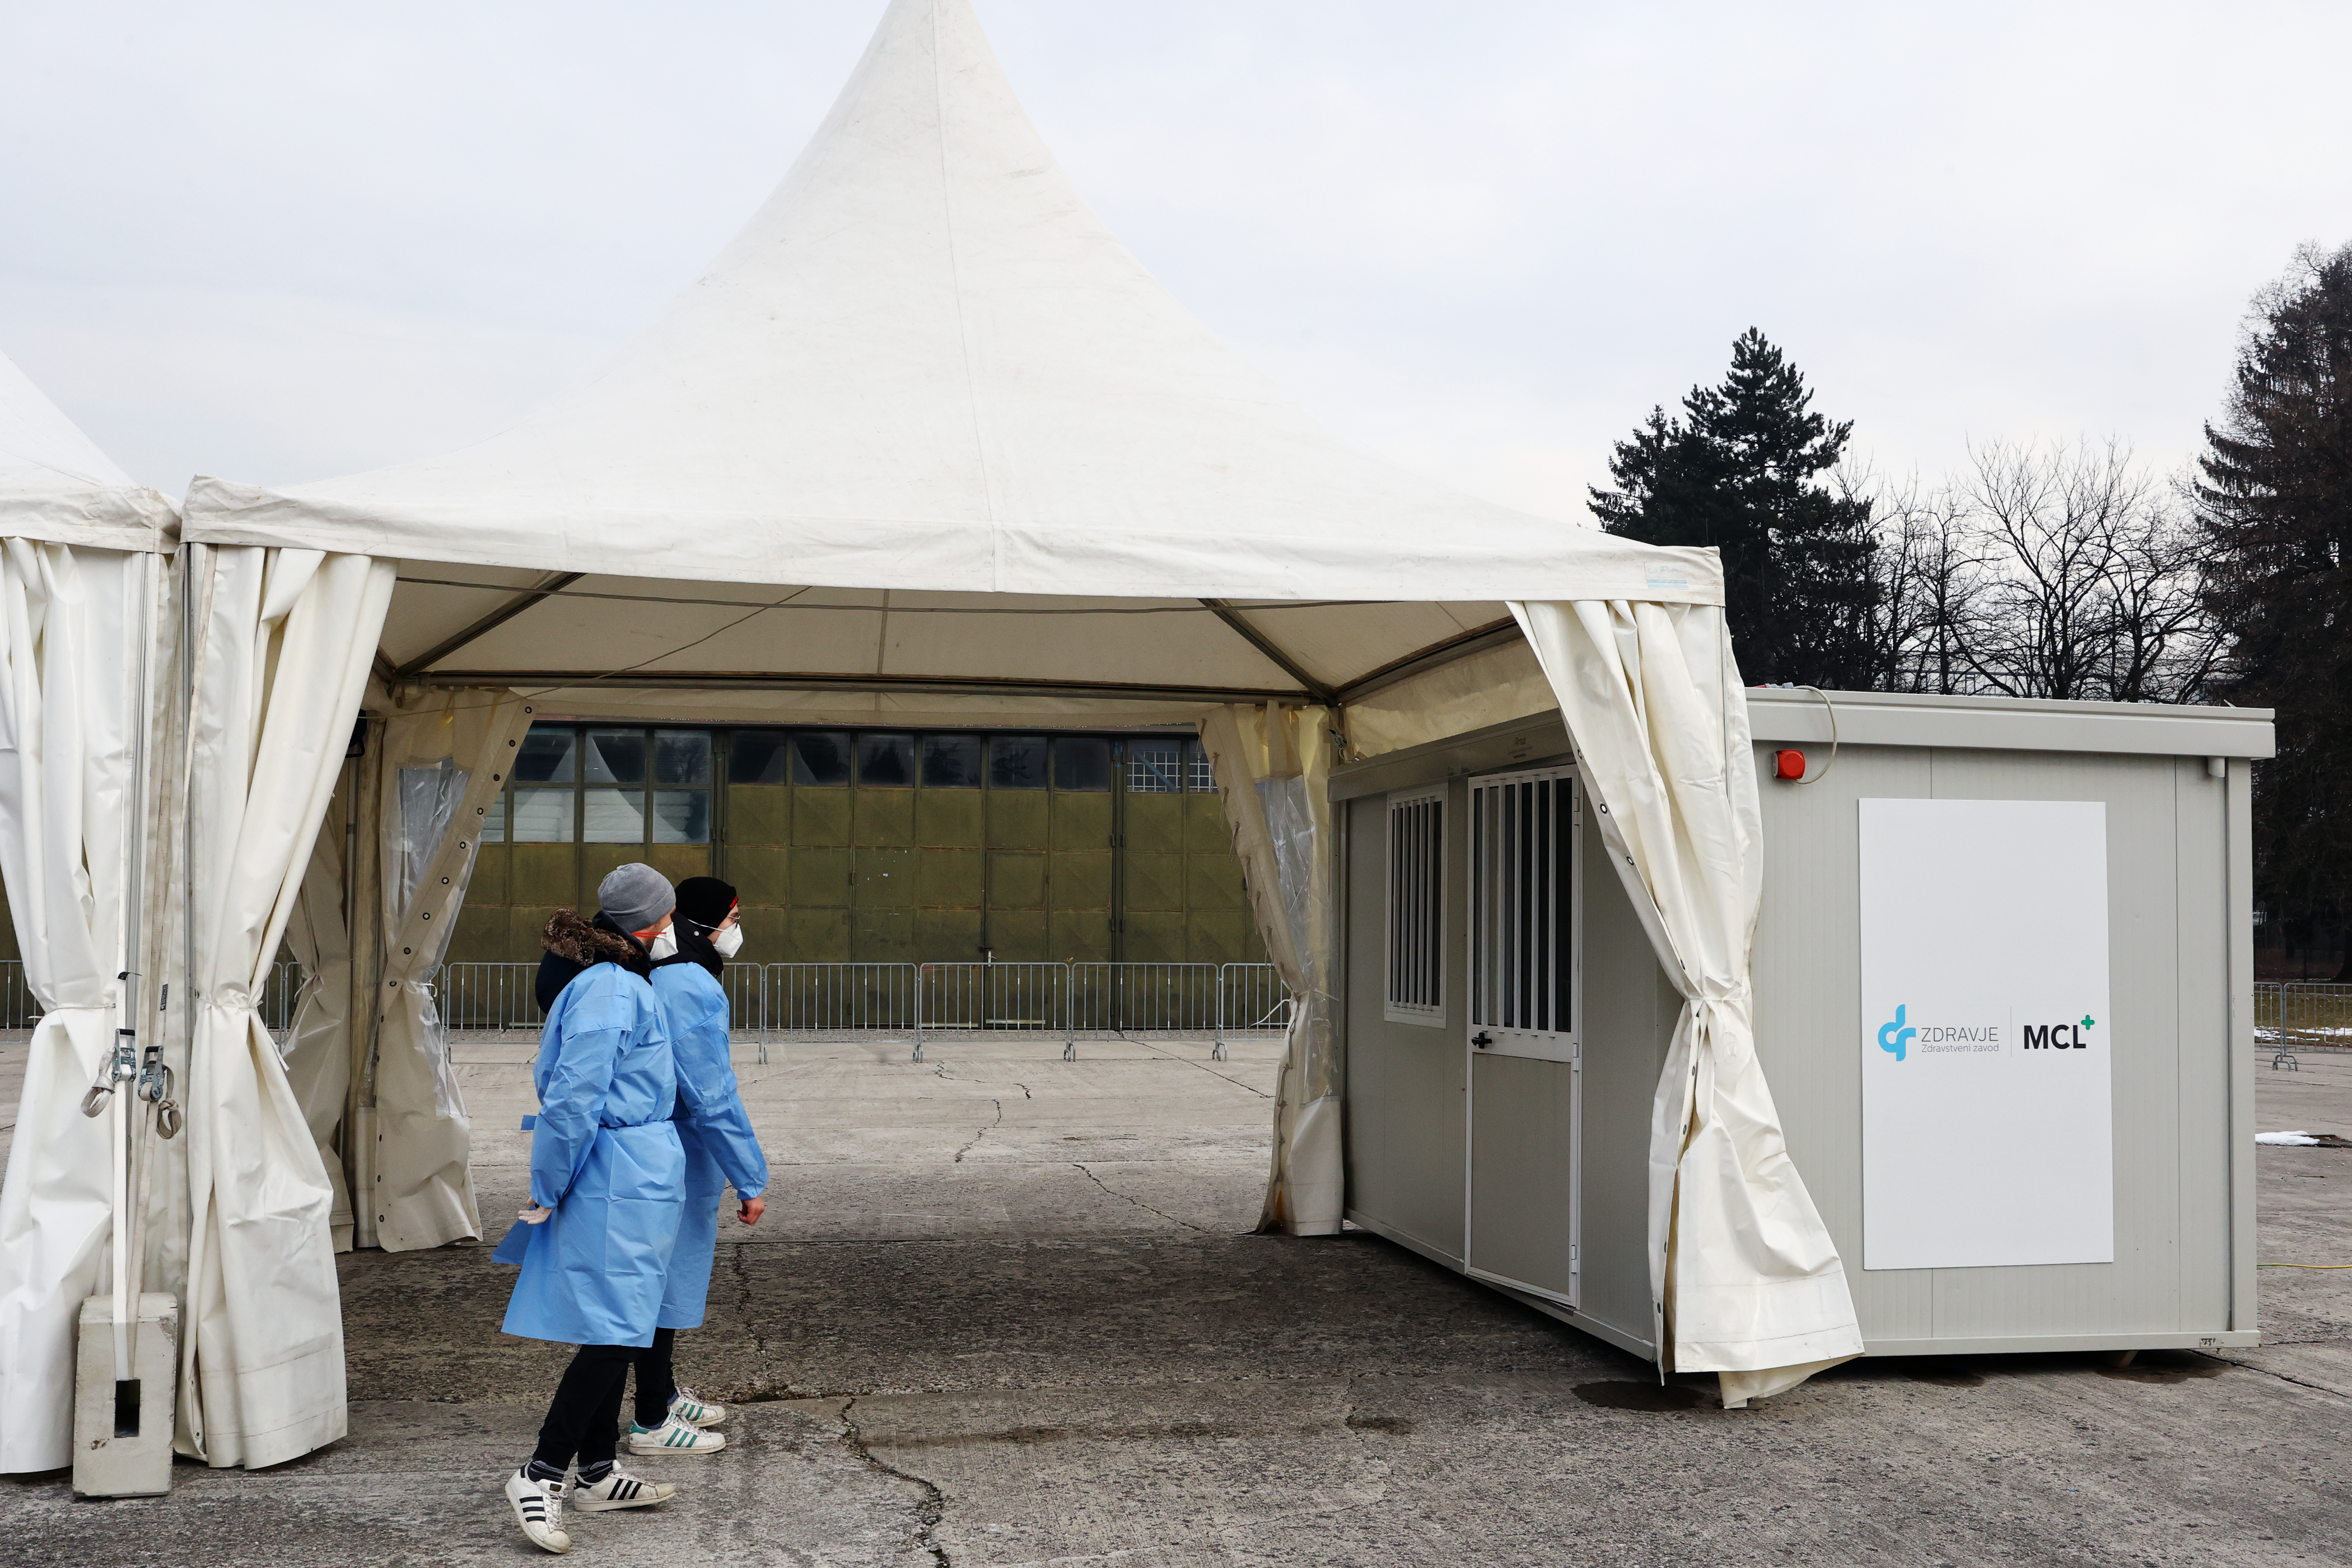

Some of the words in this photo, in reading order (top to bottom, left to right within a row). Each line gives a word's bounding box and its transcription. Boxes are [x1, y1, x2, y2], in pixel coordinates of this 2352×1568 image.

[1921, 1027, 1999, 1042] ZDRAVJE
[1921, 1044, 1971, 1052] Zdravstveni
[1973, 1043, 1999, 1052] zavod
